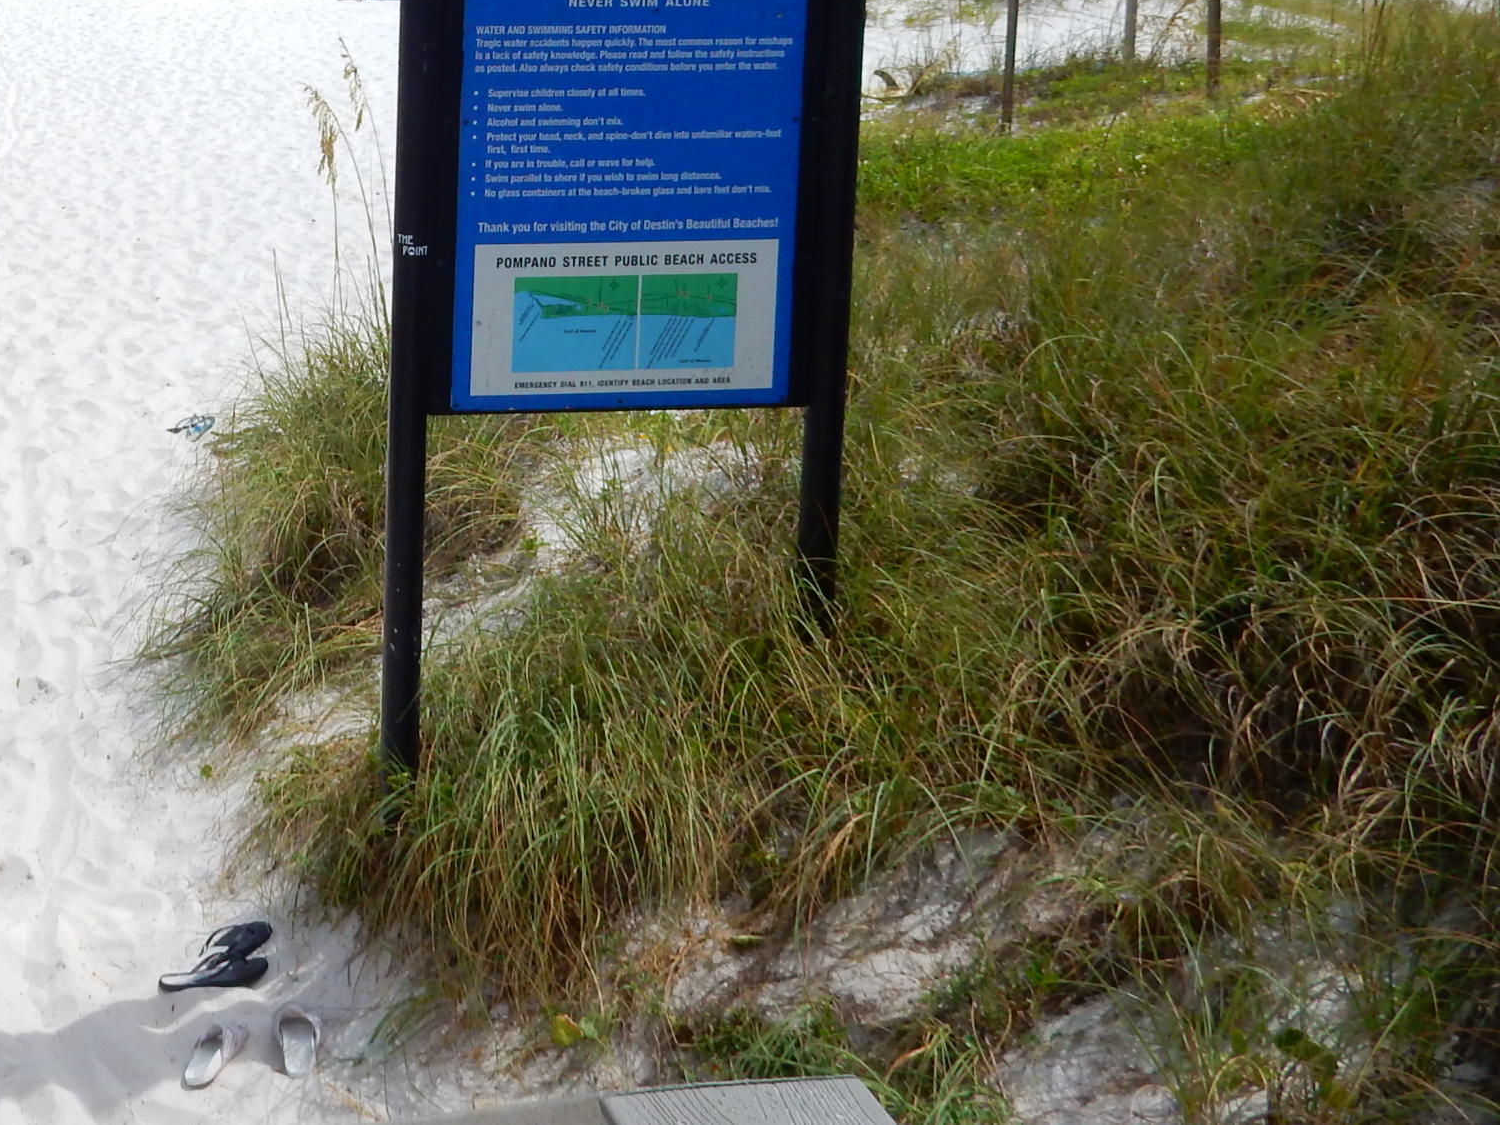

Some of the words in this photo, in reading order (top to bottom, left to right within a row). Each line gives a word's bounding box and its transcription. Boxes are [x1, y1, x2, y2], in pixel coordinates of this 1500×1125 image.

[476, 25, 504, 34] WATER
[507, 25, 525, 34] AND
[527, 25, 573, 34] SWIMMING
[575, 25, 606, 33] SAFETY
[609, 25, 666, 33] INFORMATION
[476, 38, 501, 49] Tragic
[503, 38, 527, 47] water
[529, 38, 569, 46] accidents
[571, 38, 602, 48] happen
[638, 37, 653, 46] The
[475, 51, 482, 59] is
[492, 51, 510, 59] lack
[512, 50, 520, 59] of
[522, 51, 548, 61] safety
[599, 50, 626, 59] Please
[628, 50, 648, 58] read
[649, 50, 665, 58] and
[667, 49, 692, 58] follow
[709, 49, 734, 59] safety
[519, 63, 537, 72] Also
[539, 63, 568, 73] always
[570, 63, 595, 71] check
[598, 62, 623, 73] safety
[624, 62, 668, 71] conditions
[670, 62, 696, 70] before
[698, 63, 713, 71] you
[714, 62, 736, 70] enter
[738, 61, 751, 69] the
[488, 88, 528, 98] Supervise
[530, 88, 564, 97] children
[566, 88, 595, 98] closely
[597, 88, 606, 96] at
[608, 88, 618, 96] all
[487, 103, 511, 112] Never
[487, 117, 518, 126] Alcohol
[520, 117, 535, 126] and
[537, 117, 580, 127] swimming
[582, 117, 604, 125] don't
[486, 132, 516, 141] Protect
[518, 133, 536, 142] your
[654, 130, 671, 139] dive
[673, 130, 689, 139] into
[511, 144, 527, 153] first
[485, 159, 491, 167] If
[493, 161, 508, 169] you
[569, 158, 584, 167] call
[622, 158, 633, 166] for
[484, 173, 508, 182] Swim
[510, 173, 541, 183] parallel
[544, 173, 552, 181] to
[554, 173, 577, 181] shore
[579, 173, 585, 181] if
[587, 174, 602, 183] you
[604, 172, 624, 181] wish
[636, 172, 658, 180] swim
[660, 172, 678, 181] long
[484, 188, 496, 197] No
[498, 188, 520, 198] glass
[522, 188, 565, 196] containers
[567, 188, 576, 196] at
[578, 187, 591, 195] the
[652, 186, 674, 196] glass
[676, 186, 692, 194] and
[694, 185, 712, 193] bare
[714, 185, 729, 193] feet
[731, 185, 752, 193] don't
[478, 221, 509, 232] Thank
[512, 223, 530, 234] you
[533, 221, 547, 231] for
[550, 221, 586, 233] visiting
[590, 220, 605, 231] the
[608, 220, 628, 232] City
[631, 219, 641, 230] of
[644, 219, 683, 229] Destin's
[686, 218, 730, 229] Beautiful
[733, 217, 778, 228] Beaches!
[397, 233, 414, 245] THE
[402, 245, 428, 256] POINT
[496, 256, 555, 268] POMPANO
[563, 255, 607, 267] STREET
[615, 254, 657, 266] PUBLIC
[664, 253, 703, 265] BEACH
[710, 252, 756, 264] ACCESS
